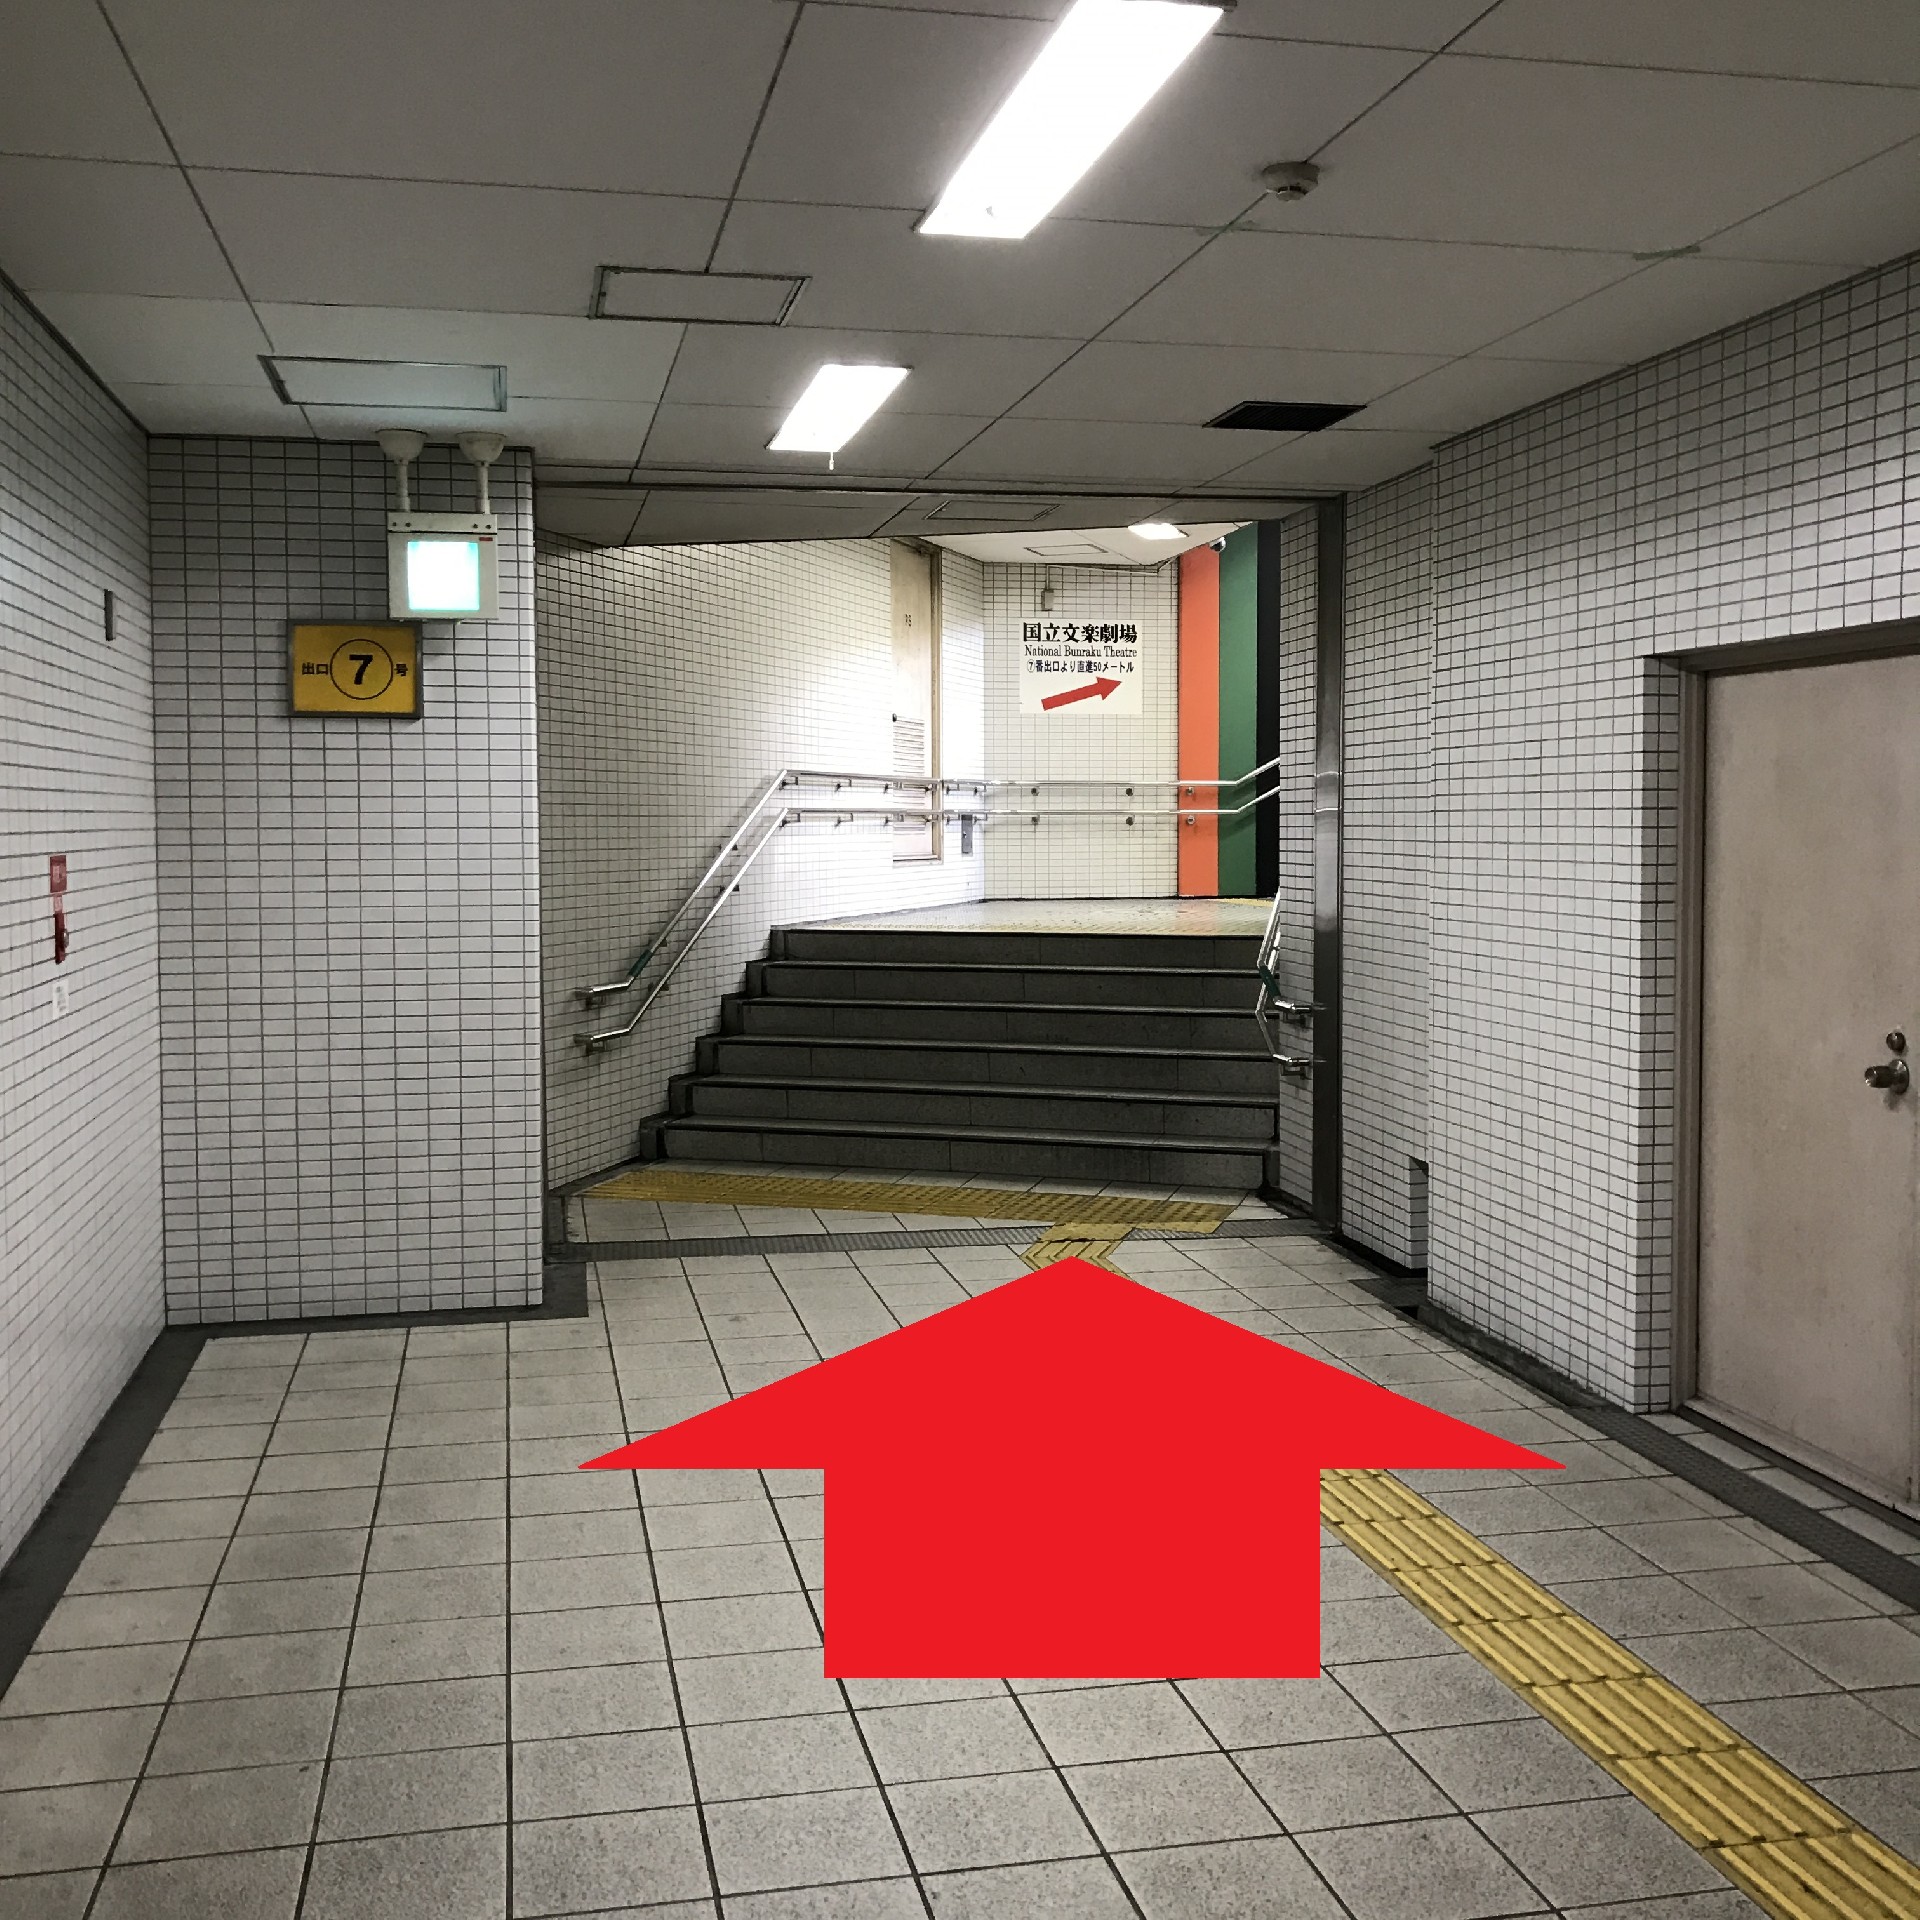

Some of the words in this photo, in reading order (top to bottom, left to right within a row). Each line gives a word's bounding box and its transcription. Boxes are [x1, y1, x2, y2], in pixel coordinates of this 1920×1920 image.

[1023, 622, 1138, 643] 国立文楽劇場
[1025, 644, 1062, 657] National
[1064, 645, 1102, 658] Bunraku
[1104, 645, 1138, 658] Theatre
[301, 662, 329, 675] 出口
[349, 654, 373, 685] 7
[394, 663, 408, 677] 号
